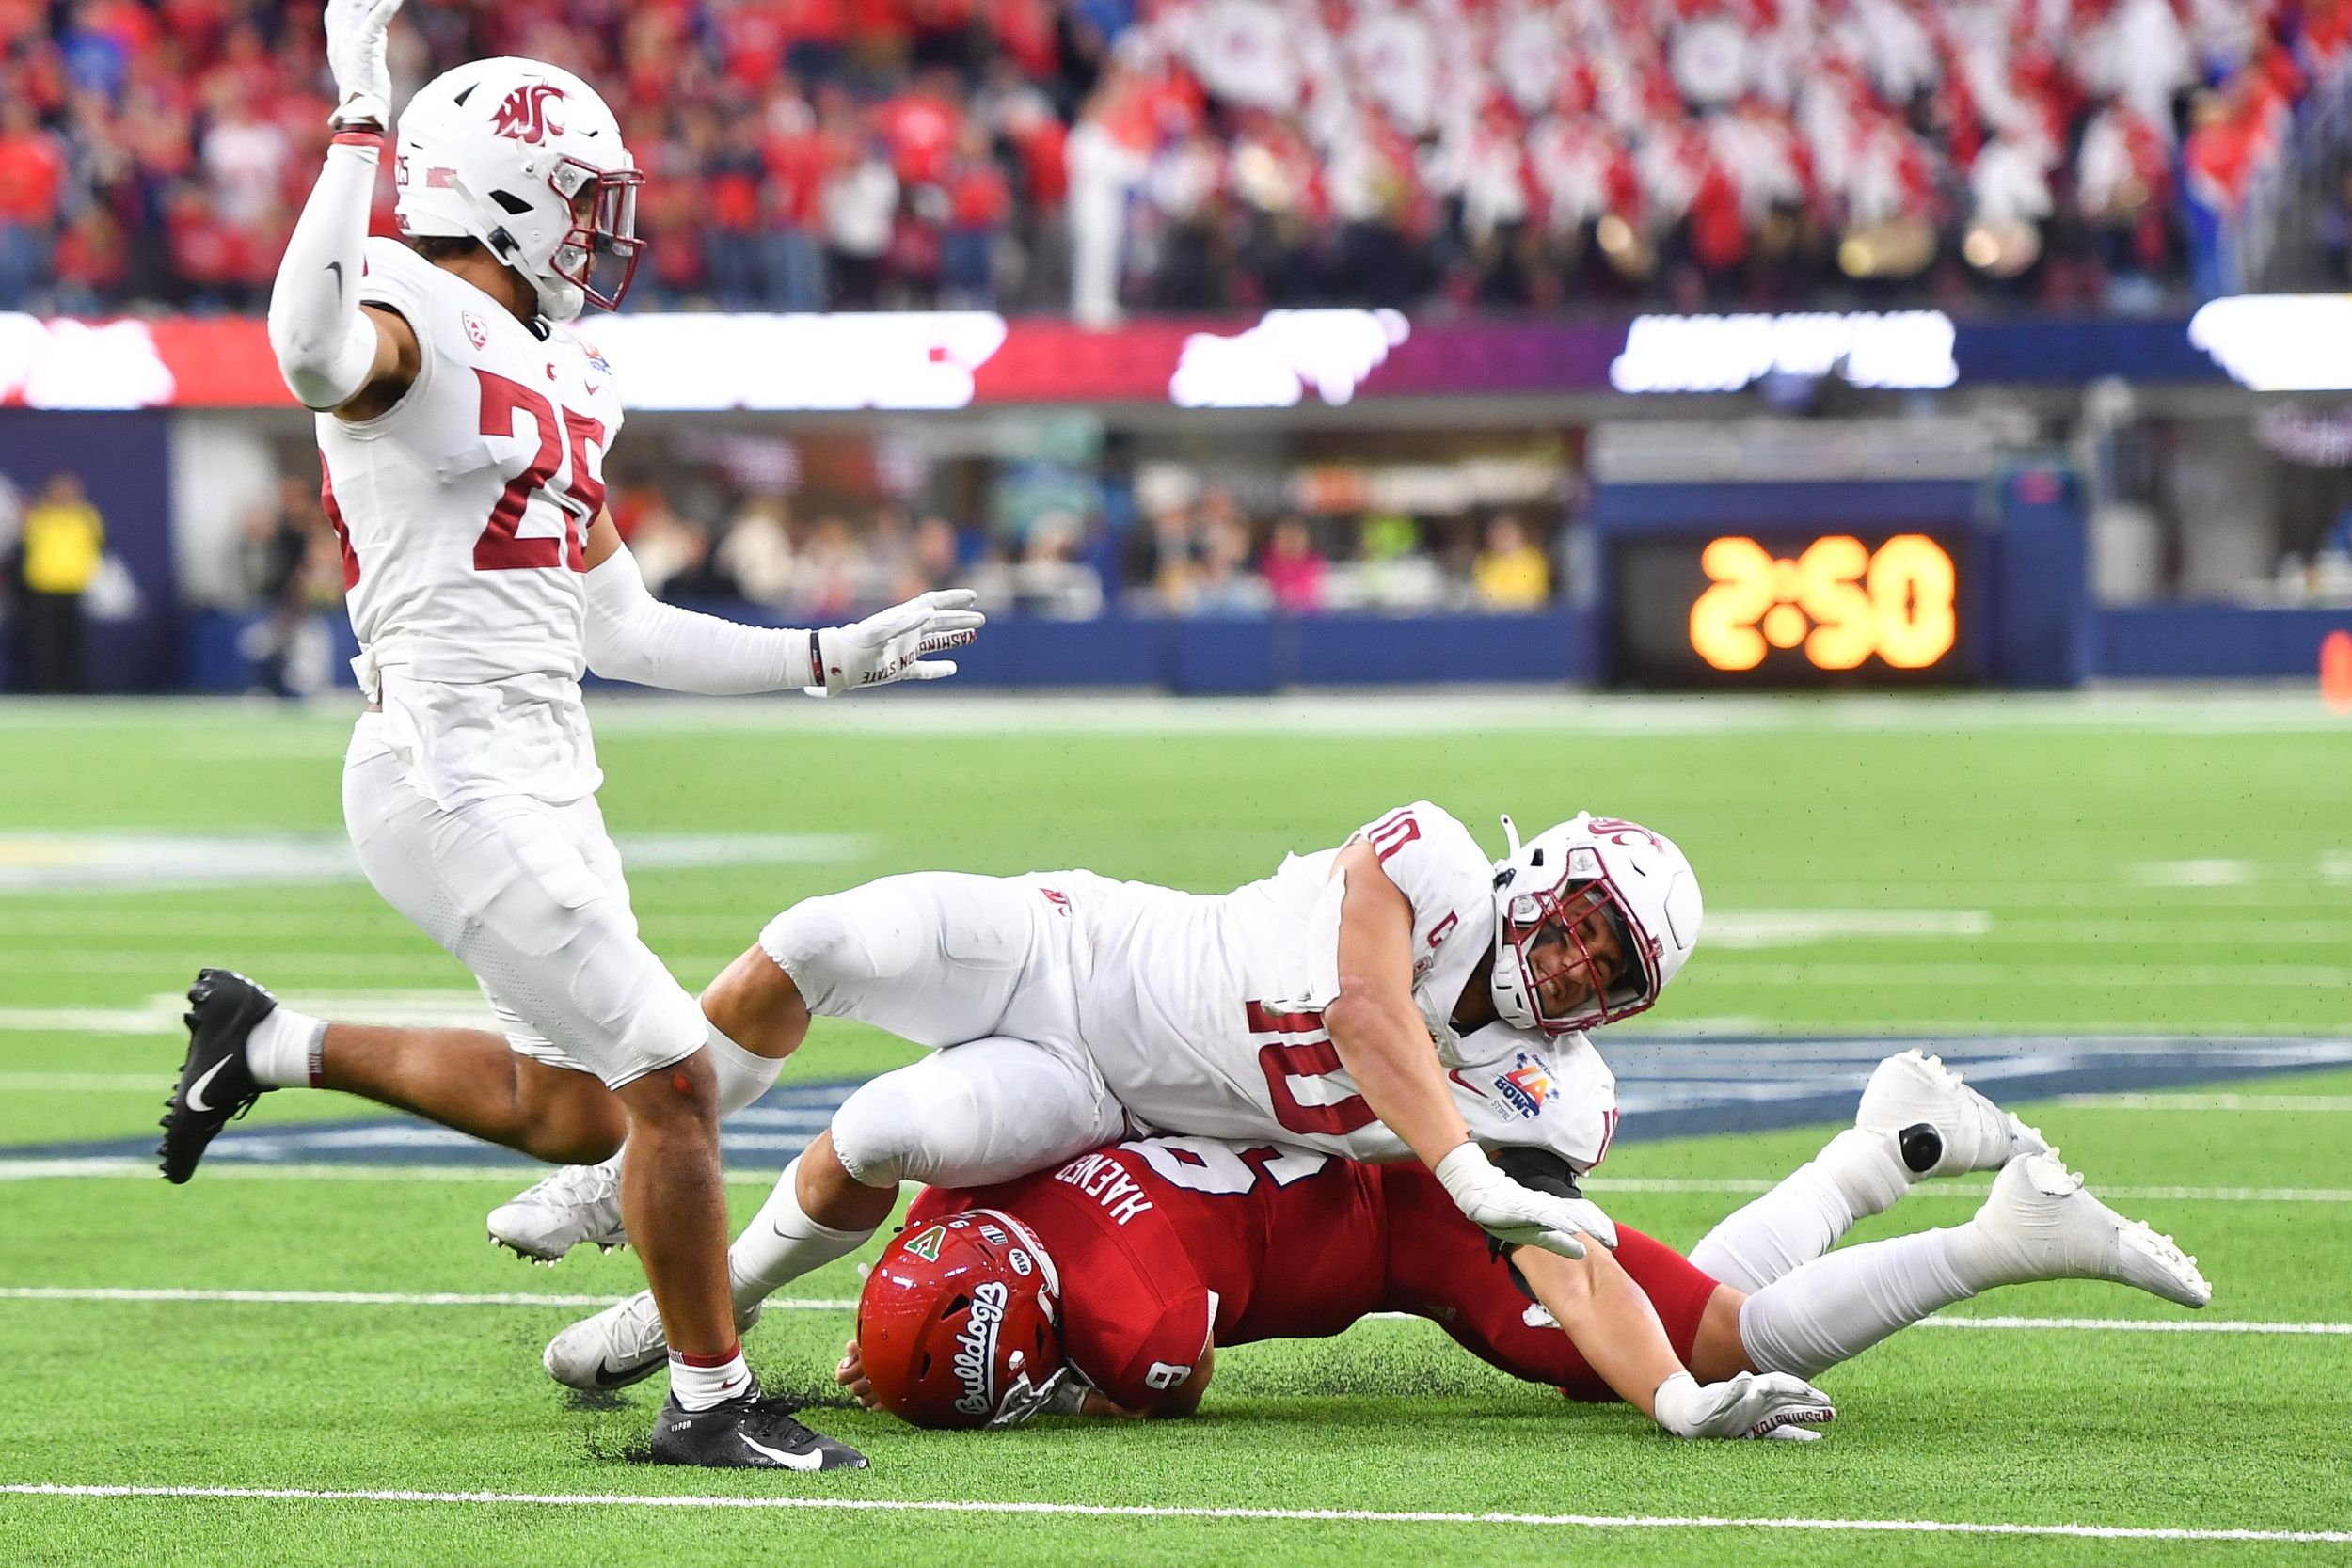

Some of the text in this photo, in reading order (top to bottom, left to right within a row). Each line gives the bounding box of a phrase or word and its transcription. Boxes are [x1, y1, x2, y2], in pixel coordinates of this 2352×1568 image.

[469, 366, 606, 574] 25
[1690, 533, 1956, 671] 2:50
[860, 662, 897, 684] STATE
[1493, 1078, 1532, 1119] BOWL
[1505, 1065, 1549, 1108] LA
[1054, 1152, 1154, 1226] HAENER
[1011, 1251, 1029, 1274] BW
[954, 1280, 1009, 1415] Bulldogs
[1751, 1409, 1834, 1438] WASHINGTON
